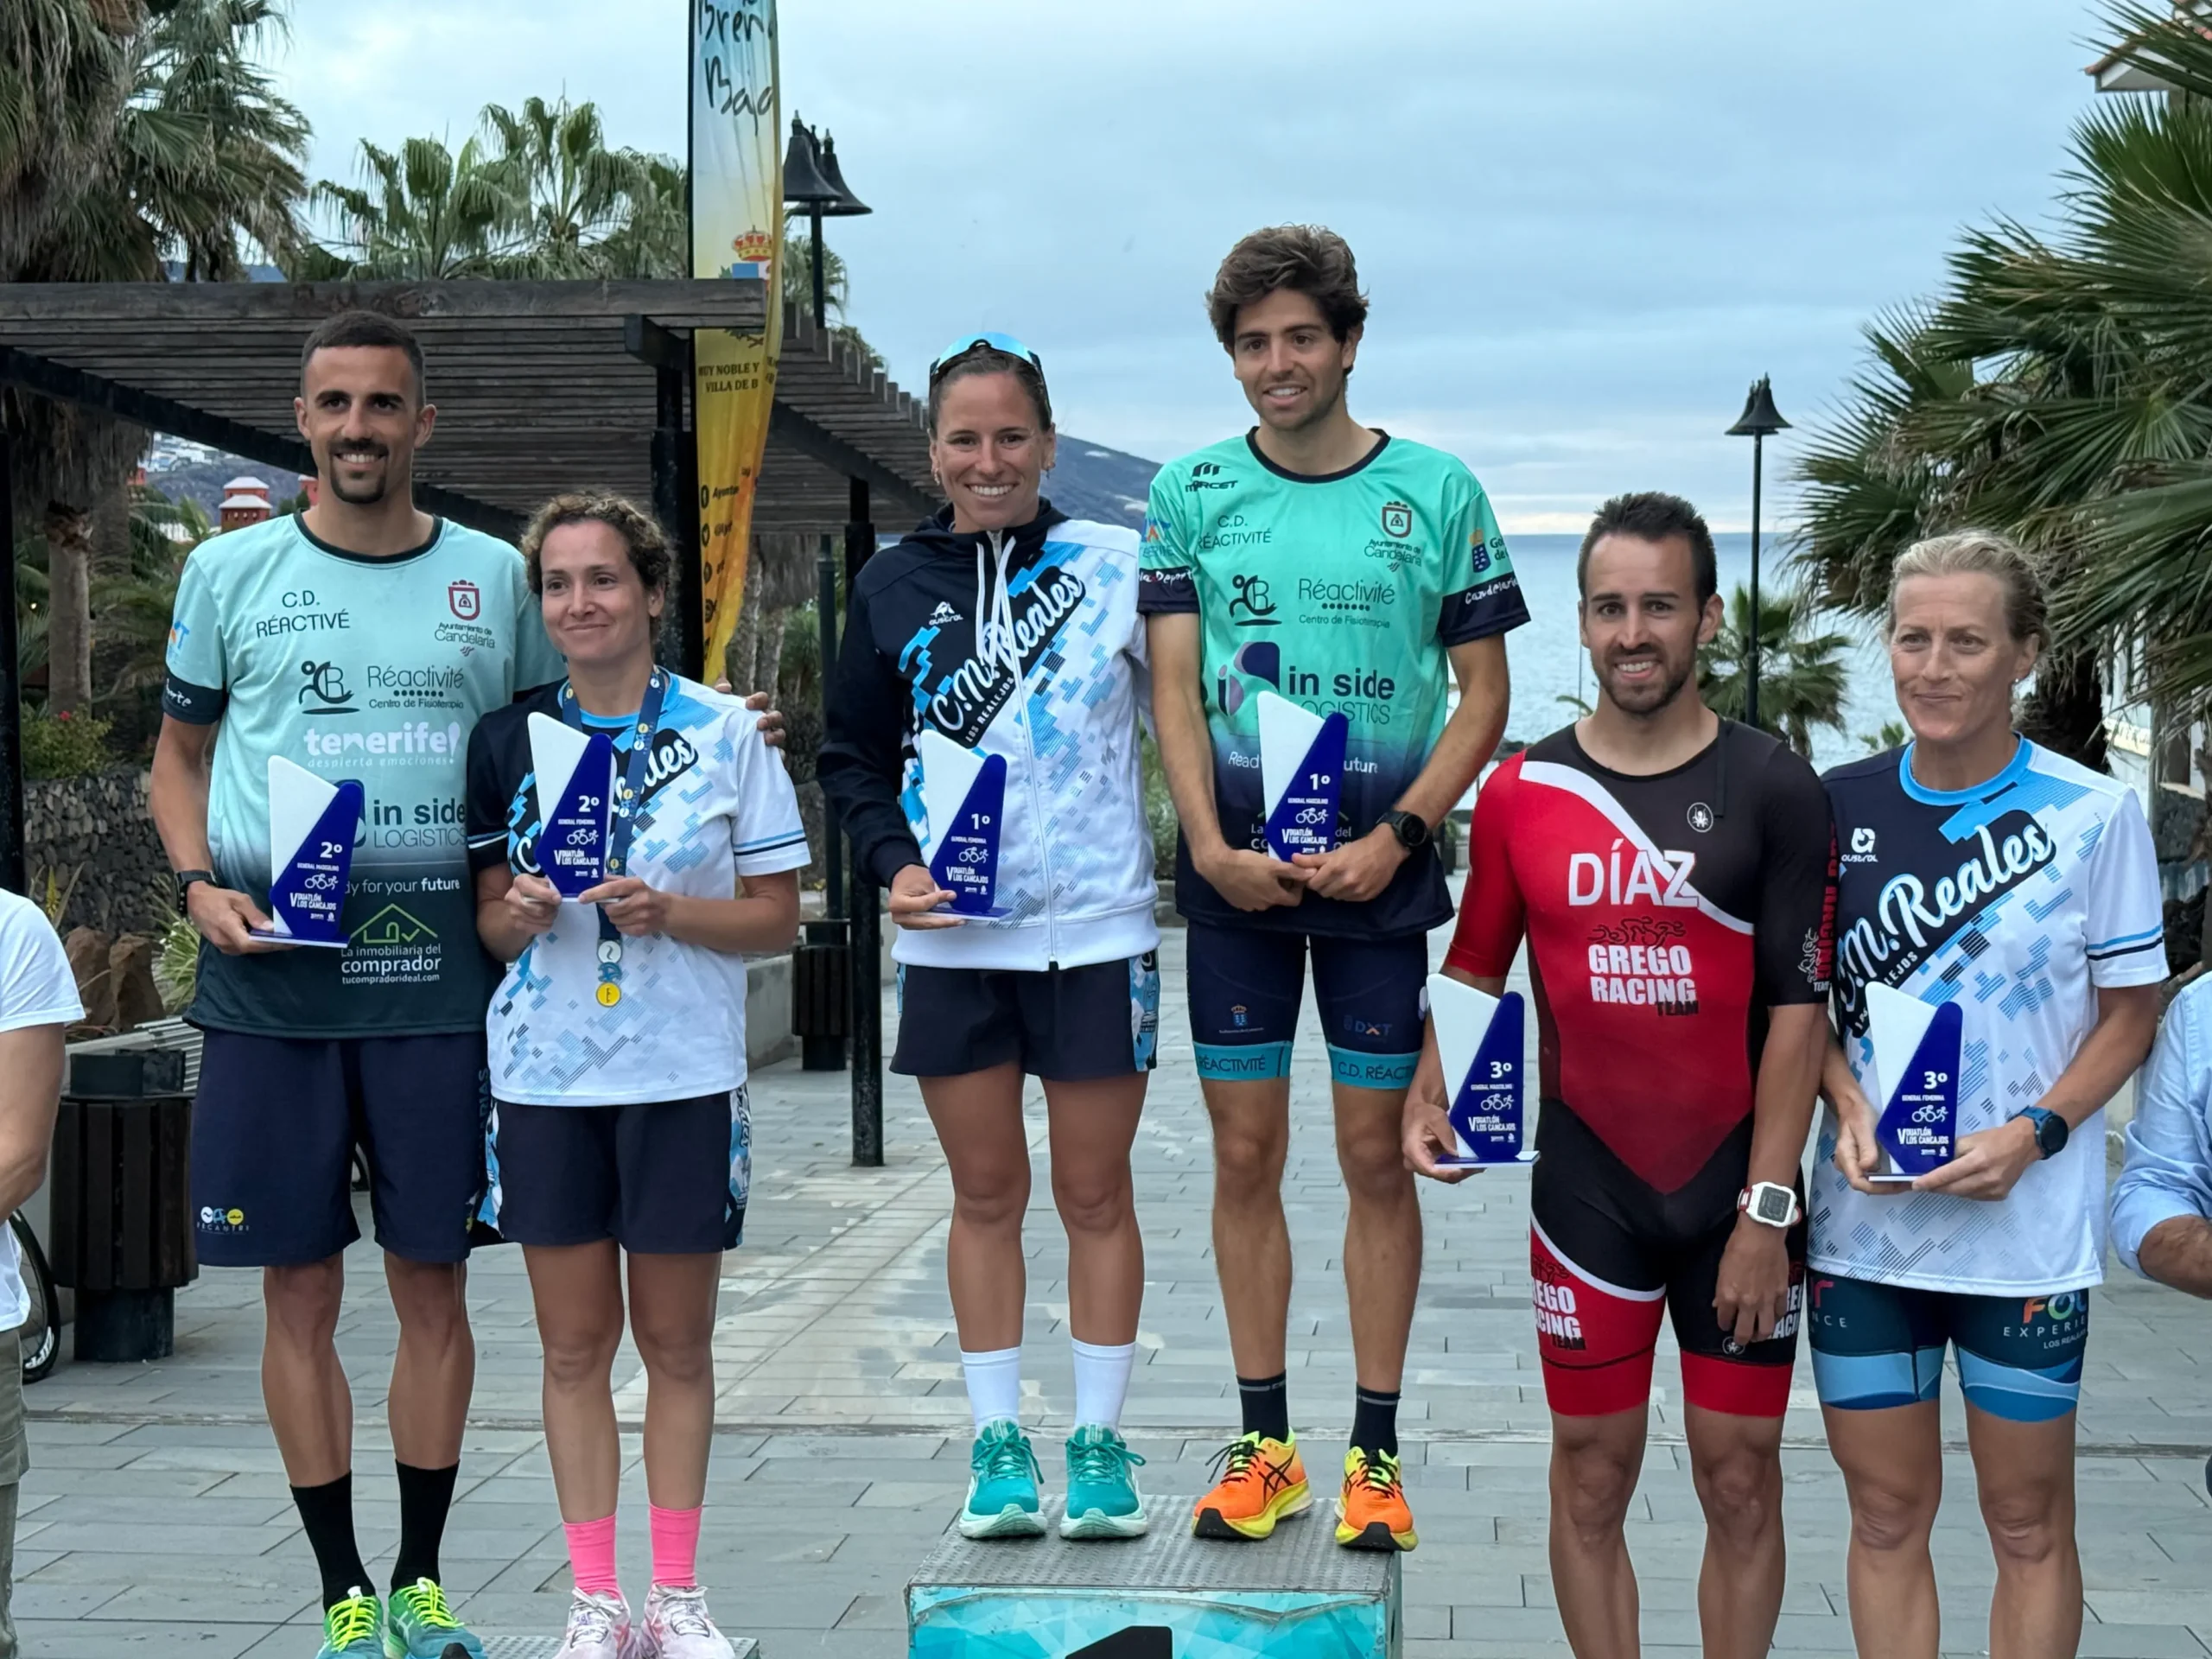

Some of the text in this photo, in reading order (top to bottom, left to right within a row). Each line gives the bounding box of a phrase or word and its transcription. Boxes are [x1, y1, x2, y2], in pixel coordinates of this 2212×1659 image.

[716, 363, 750, 376] NOBLE
[753, 361, 760, 373] Y
[706, 380, 733, 392] VILLA
[734, 379, 749, 391] DE
[1217, 514, 1248, 528] C.D.
[1363, 546, 1422, 567] Candelaria
[282, 590, 321, 607] C.D.
[1299, 578, 1395, 605] Réactivité
[256, 608, 350, 639] RÉACTIVÉ
[1299, 614, 1390, 629] Centro de Fisioterapia
[434, 629, 495, 649] Candelaria
[367, 664, 464, 690] Réactivité
[1288, 665, 1395, 700] in side
[368, 698, 464, 710] Centro de Fisioterapia
[965, 676, 1015, 742] LOS REALEJOS
[1300, 701, 1390, 725] OGISTICS
[308, 757, 373, 769] despierta
[1228, 751, 1262, 769] Read
[373, 798, 467, 826] in side
[1568, 838, 1700, 907] DÍAZ
[362, 878, 383, 893] for
[385, 880, 418, 896] your
[421, 877, 461, 892] future
[356, 944, 423, 957] inmobiliaria
[425, 943, 442, 955] del
[340, 954, 442, 976] comprador
[1587, 944, 1693, 976] GREGO
[342, 973, 440, 985] tucompradorideal.com
[1590, 976, 1697, 1005] RACING
[1656, 1000, 1700, 1016] TEAM
[1338, 1061, 1363, 1078] C.D.
[1533, 1279, 1577, 1314] EGO
[2044, 1339, 2061, 1349] LOS
